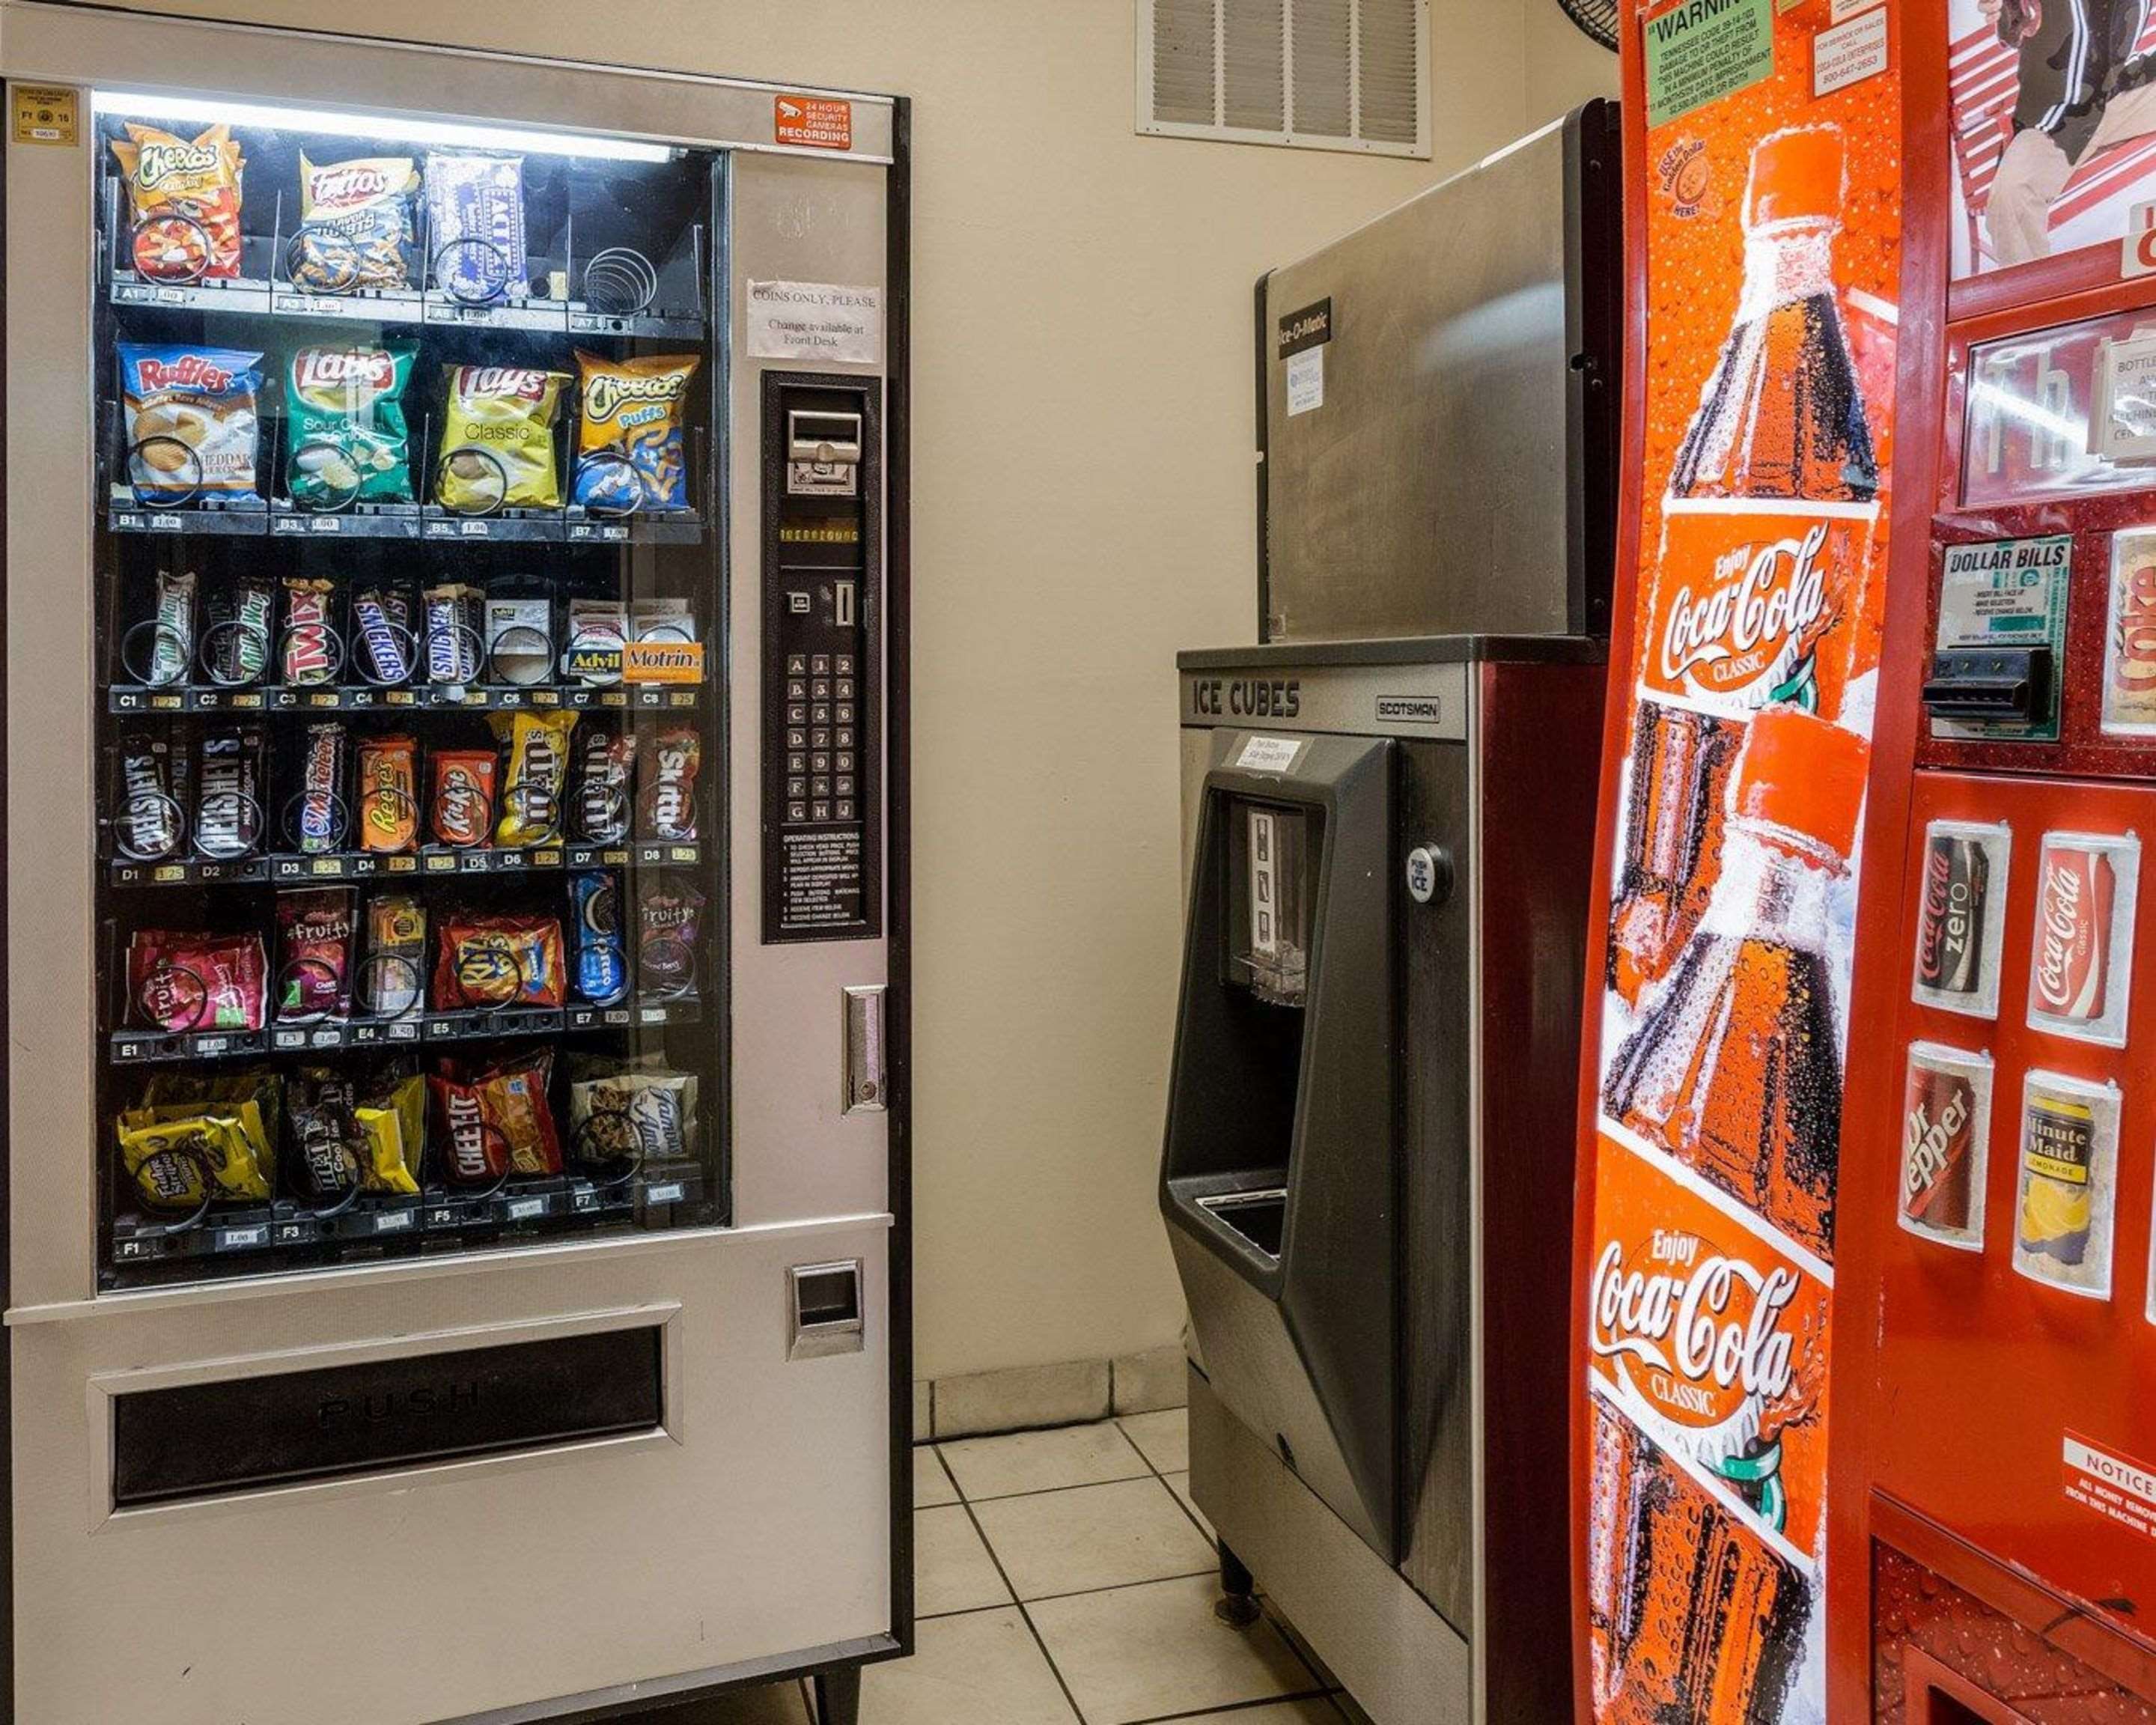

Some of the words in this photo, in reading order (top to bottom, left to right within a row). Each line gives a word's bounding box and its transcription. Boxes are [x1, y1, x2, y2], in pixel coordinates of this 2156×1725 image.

[779, 127, 849, 142] RECORDING
[137, 356, 232, 395] Ruffles
[464, 422, 530, 440] Classic
[1714, 544, 1752, 581] Enjoy
[1950, 550, 2012, 573] DOLLAR
[2016, 545, 2065, 568] BILLS
[1662, 518, 1830, 681] Coca-Cola
[573, 652, 621, 669] Advil
[629, 649, 693, 667] Motrin
[792, 660, 803, 670] A
[818, 660, 823, 670] 1
[841, 660, 849, 670] 2
[1713, 650, 1766, 683] CLASSIC
[792, 685, 802, 695] B
[817, 684, 825, 695] 3
[841, 685, 849, 695] 4
[119, 696, 137, 707] C1
[200, 694, 218, 705] C2
[279, 693, 296, 705] C3
[356, 693, 373, 704] C4
[574, 693, 589, 704] C7
[1193, 680, 1222, 715] ICE
[1230, 680, 1300, 718] CUBES
[792, 709, 802, 719] C
[817, 709, 825, 719] 5
[841, 709, 849, 719] 6
[1378, 702, 1437, 717] SCOTSMAN
[792, 734, 803, 743] D
[817, 734, 825, 743] 7
[841, 733, 849, 743] 8
[793, 758, 802, 768] E
[817, 758, 825, 767] 9
[841, 757, 849, 767] 0
[793, 782, 802, 792] F
[656, 749, 686, 838] Skittle
[792, 806, 803, 817] G
[816, 806, 826, 816] H
[841, 806, 849, 815] J
[576, 852, 591, 862] D7
[281, 862, 299, 874] D3
[358, 859, 375, 870] D4
[1946, 883, 1969, 955] zero
[2038, 860, 2081, 1006] Coca-Cola
[576, 1013, 592, 1023] E7
[359, 1028, 375, 1039] E4
[433, 1023, 448, 1033] E5
[122, 1044, 137, 1056] E1
[576, 1196, 591, 1206] F7
[435, 1211, 450, 1221] F5
[283, 1226, 299, 1238] F3
[124, 1244, 138, 1254] F1
[1652, 1229, 1699, 1267] Enjoy
[1592, 1240, 1800, 1399] Coca-Cola
[1651, 1374, 1717, 1418] CLASSIC
[2086, 1453, 2153, 1496] NOTICE
